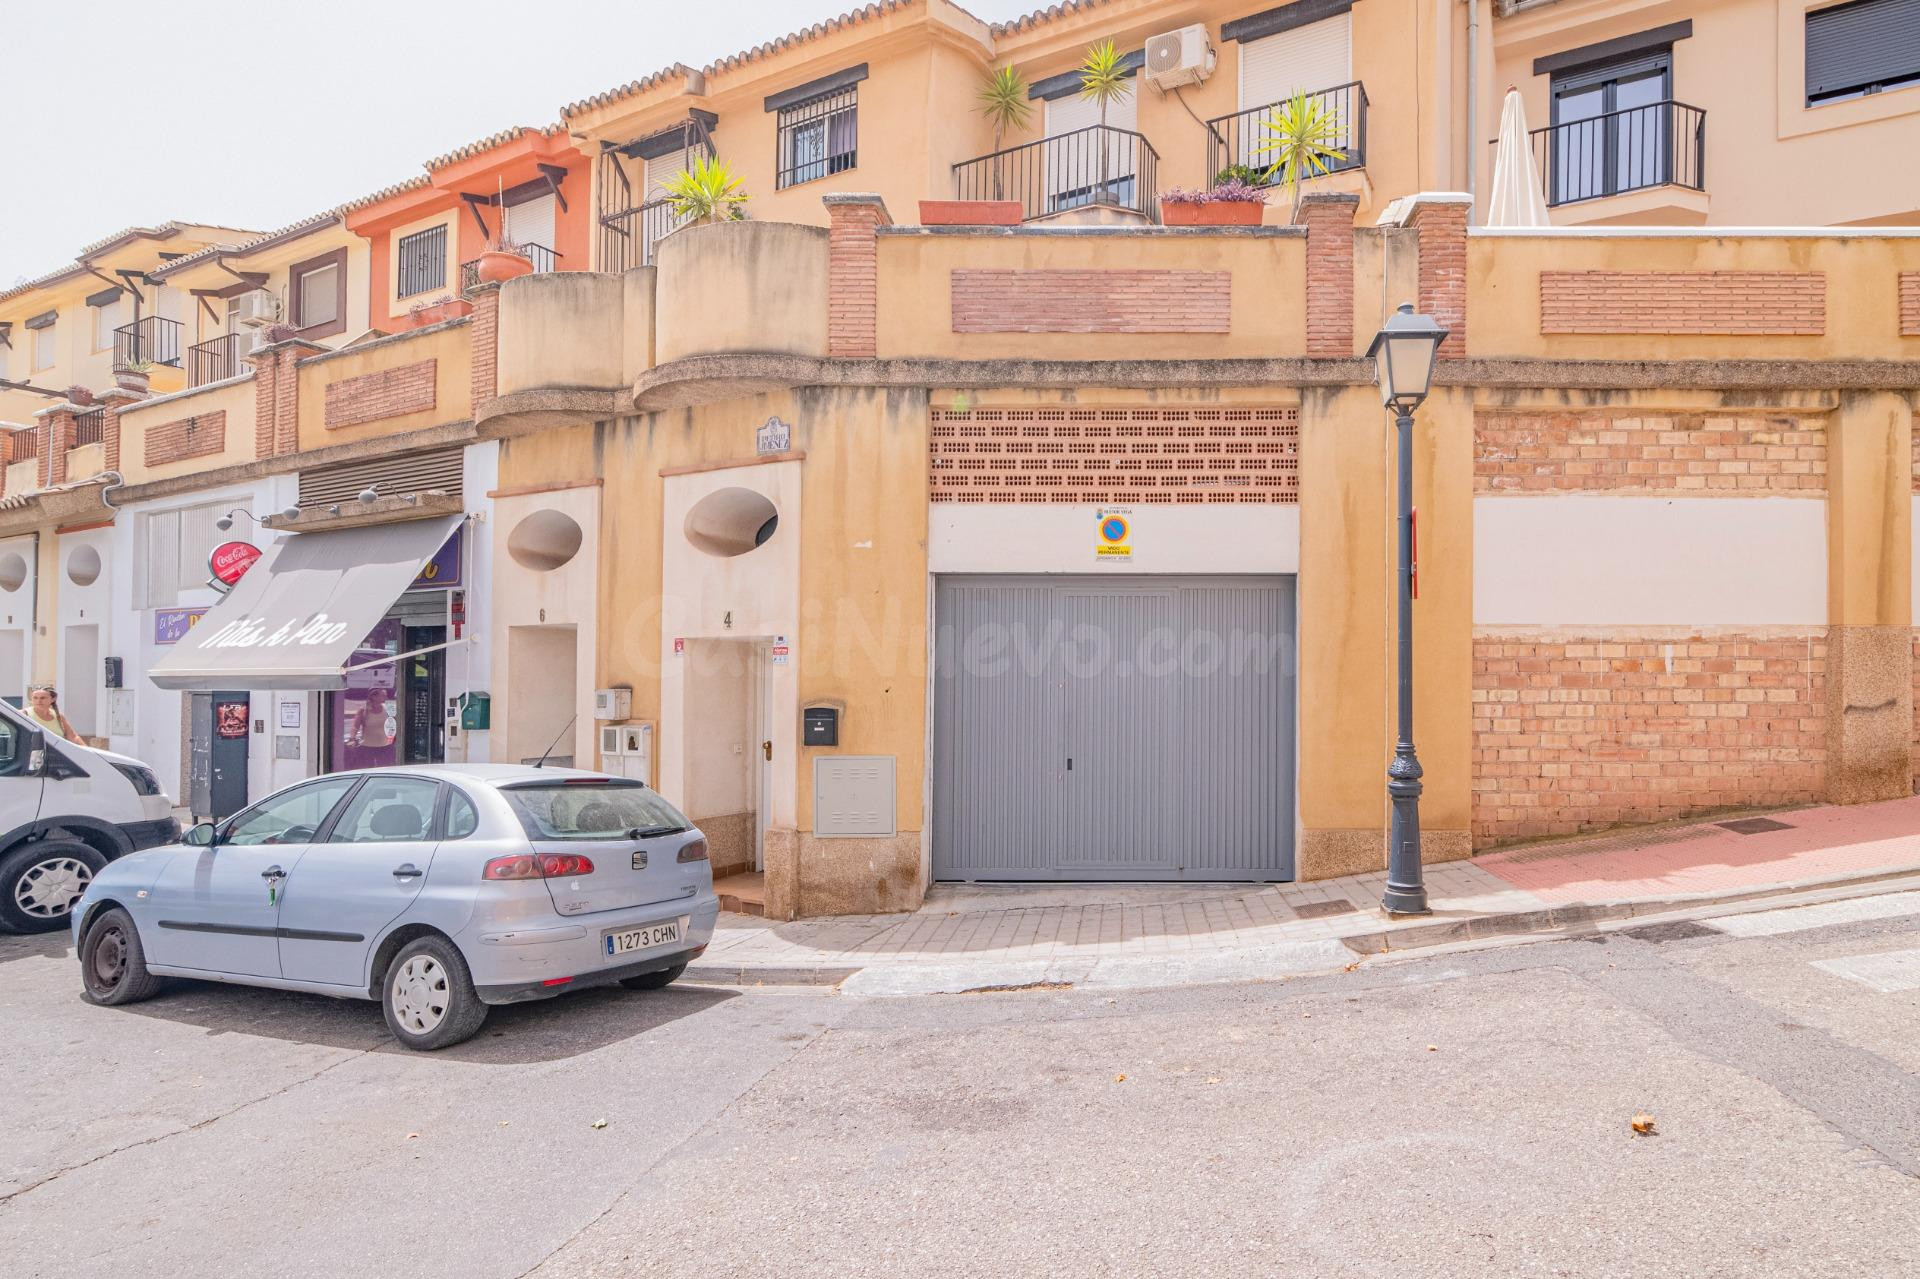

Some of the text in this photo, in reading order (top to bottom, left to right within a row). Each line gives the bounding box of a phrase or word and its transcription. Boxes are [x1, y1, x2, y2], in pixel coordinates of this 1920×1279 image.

[539, 608, 546, 623] 6
[723, 610, 733, 628] 4
[617, 925, 677, 951] 1273 CHN
